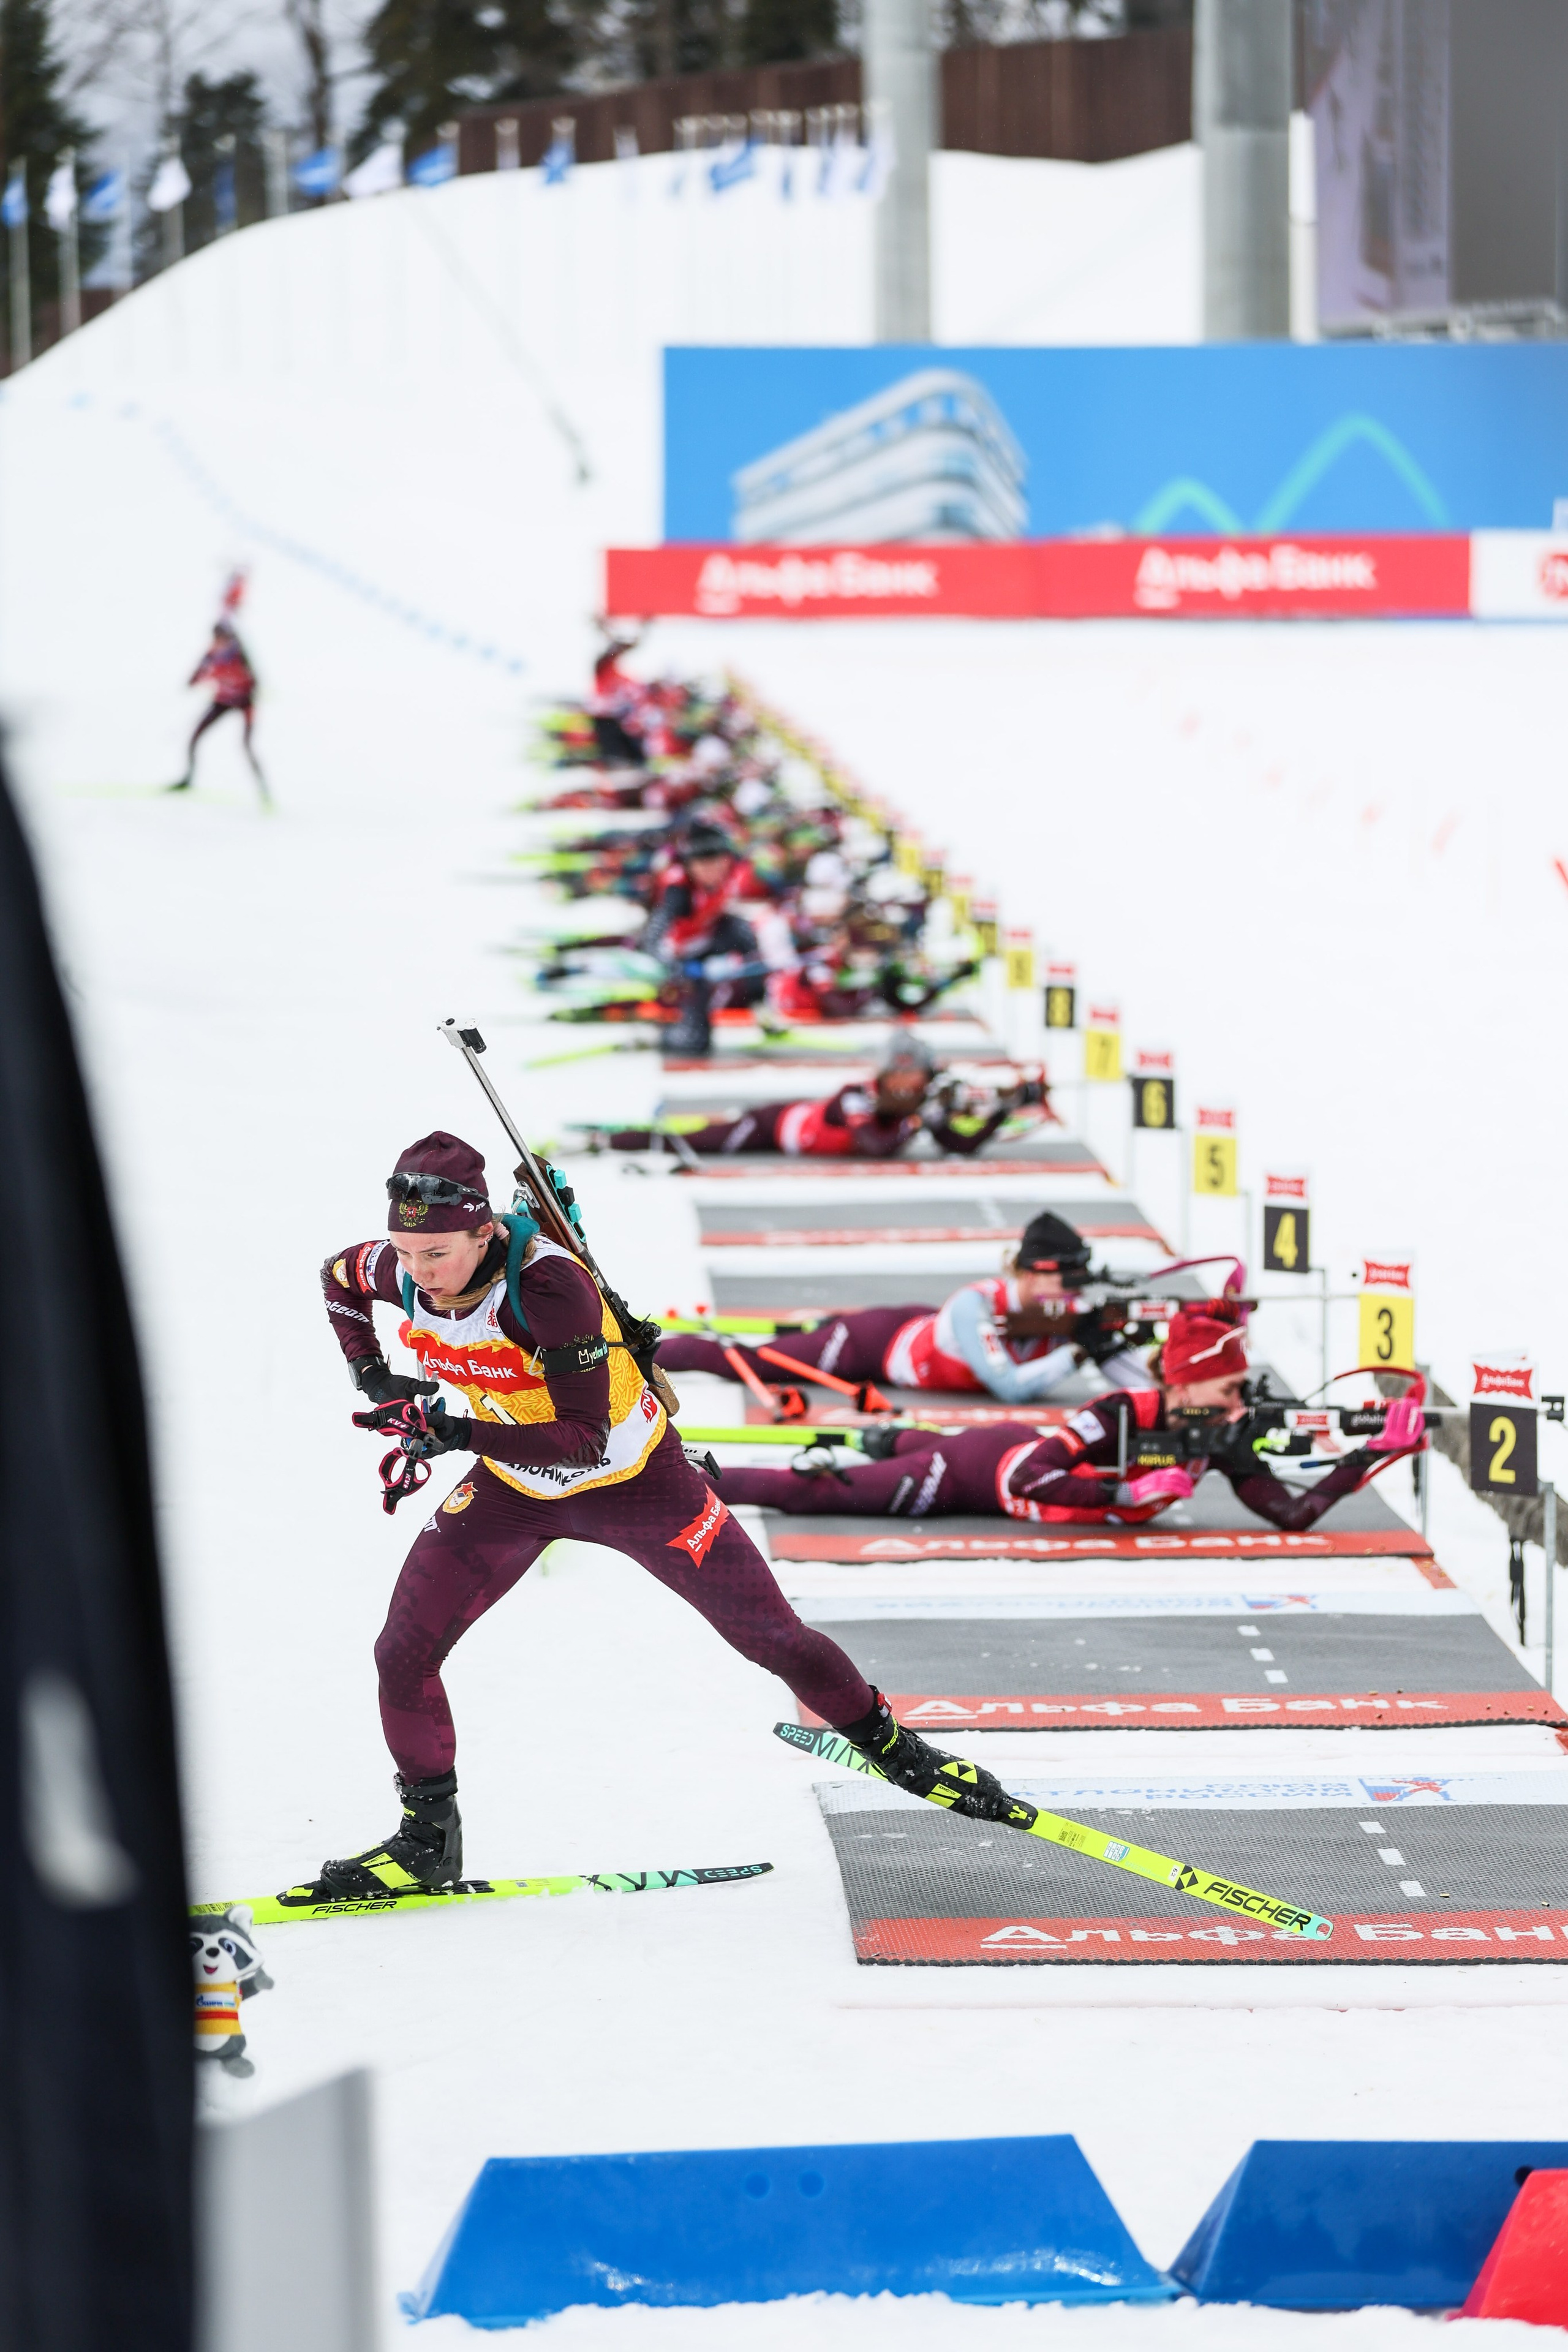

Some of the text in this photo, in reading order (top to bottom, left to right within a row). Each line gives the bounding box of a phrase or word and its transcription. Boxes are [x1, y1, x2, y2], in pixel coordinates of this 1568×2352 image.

[1142, 1080, 1167, 1128] 6
[1207, 1144, 1225, 1188] 5
[1273, 1212, 1298, 1268] 4
[1377, 1308, 1394, 1361] 3
[423, 1350, 518, 1379] Альфа Банк
[386, 1417, 409, 1429] KV+
[1488, 1415, 1517, 1485] 2
[402, 1472, 412, 1489] KV+
[687, 1498, 722, 1552] Альфа Банк
[859, 1534, 1334, 1555] Альфа Банк
[903, 1698, 1449, 1721] Альфа Банк
[780, 1724, 815, 1746] SPEED
[704, 1865, 763, 1879] SPEED
[311, 1900, 398, 1915] FISCHER
[1204, 1880, 1312, 1931] FISCHER
[1354, 1923, 1568, 1941] Бан
